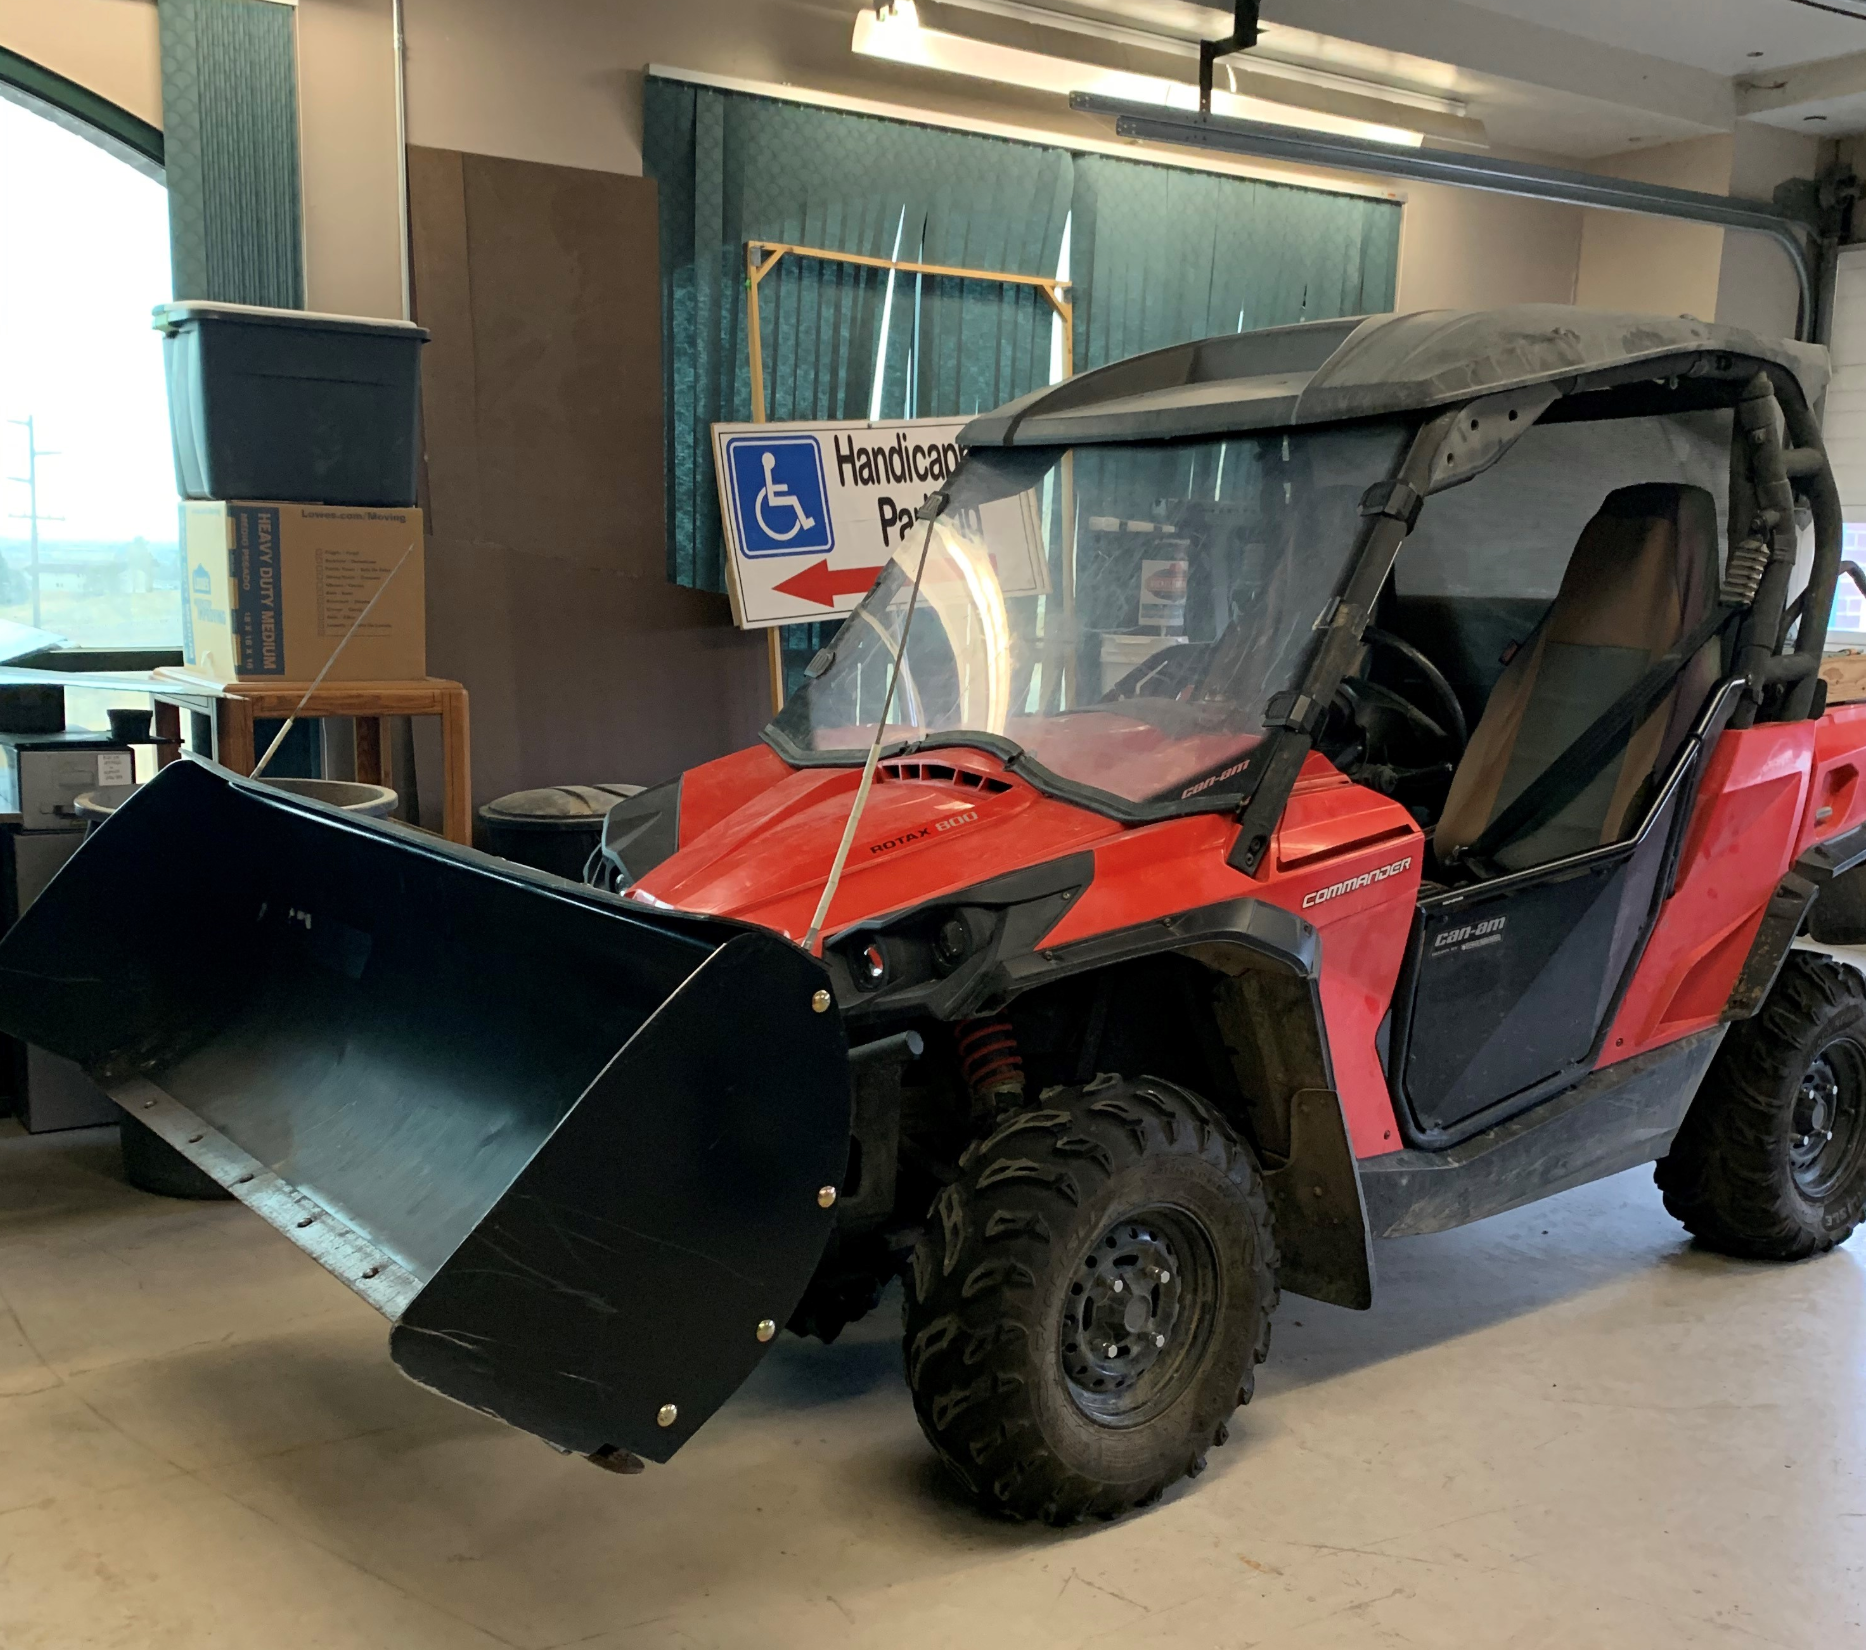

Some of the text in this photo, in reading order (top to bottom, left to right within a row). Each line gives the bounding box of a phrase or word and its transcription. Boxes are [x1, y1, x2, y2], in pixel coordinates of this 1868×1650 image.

[242, 548, 250, 591] PESADO
[258, 513, 276, 669] HEAVY DUTY MEDIUM
[1181, 759, 1250, 799] can-am
[870, 811, 978, 853] ROTAX 800
[1302, 857, 1411, 908] COMMANDER
[1434, 916, 1506, 947] can-am
